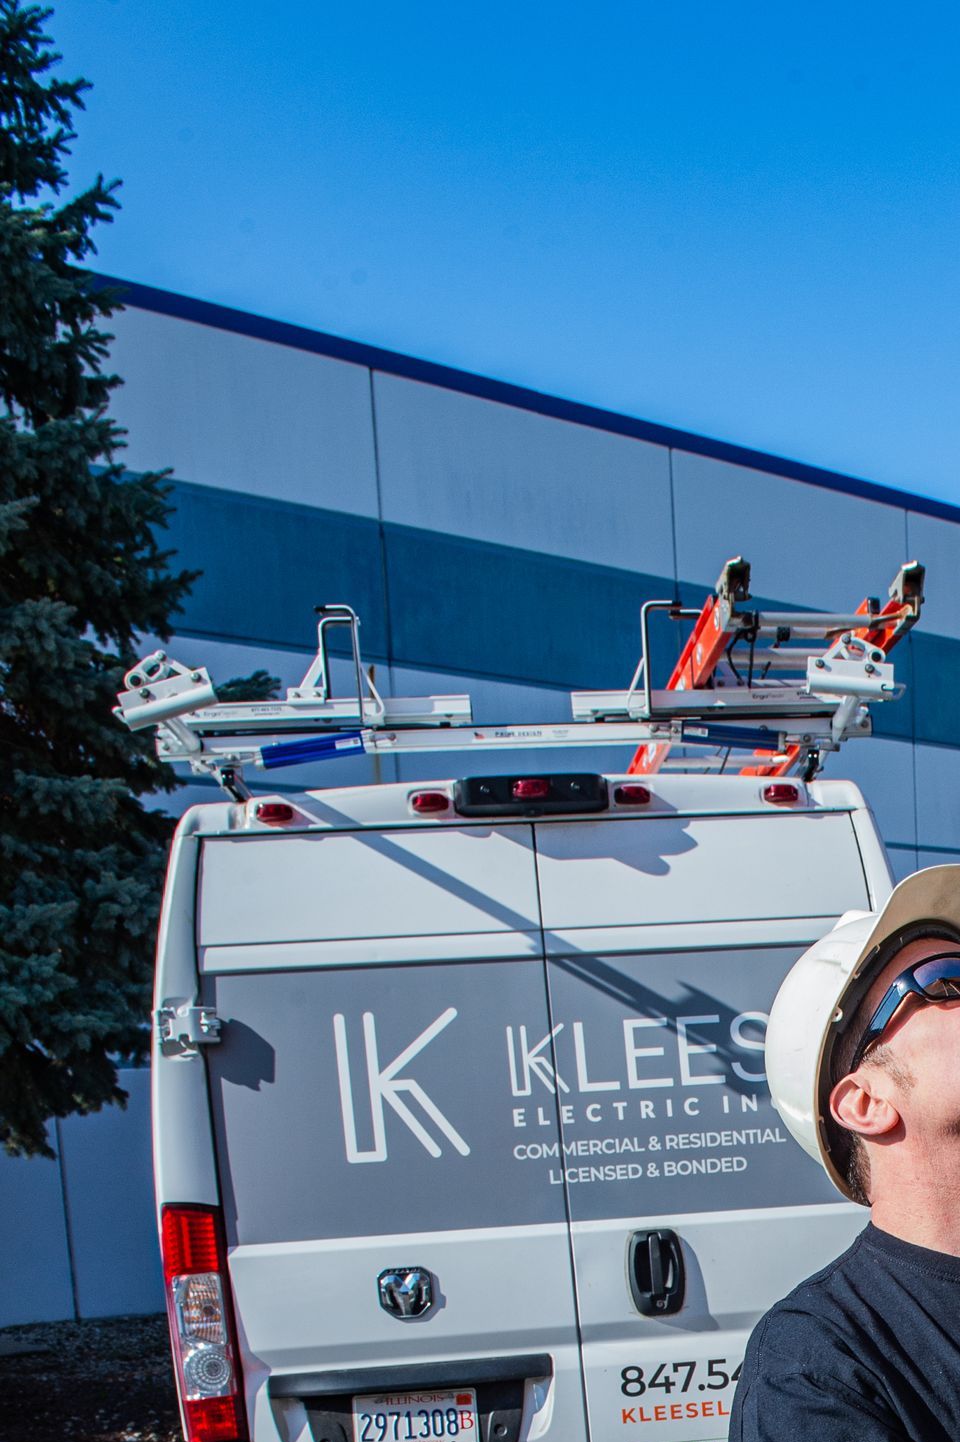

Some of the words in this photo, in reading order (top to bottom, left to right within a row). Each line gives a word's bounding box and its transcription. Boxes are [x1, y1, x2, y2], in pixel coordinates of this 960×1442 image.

[506, 1011, 769, 1097] KLEES
[512, 1096, 701, 1128] ELECTRIC
[723, 1093, 774, 1115] IN
[513, 1136, 646, 1160] COMMERCIAL
[648, 1136, 663, 1152] &
[665, 1127, 787, 1151] RESIDENTIAL
[548, 1162, 643, 1186] LICENSED
[646, 1161, 661, 1178] &
[664, 1156, 748, 1178] BONDED
[385, 1392, 445, 1406] ILLINOIS
[621, 1400, 730, 1425] KLEESEL
[360, 1407, 460, 1442] 2971308
[460, 1409, 475, 1430] B
